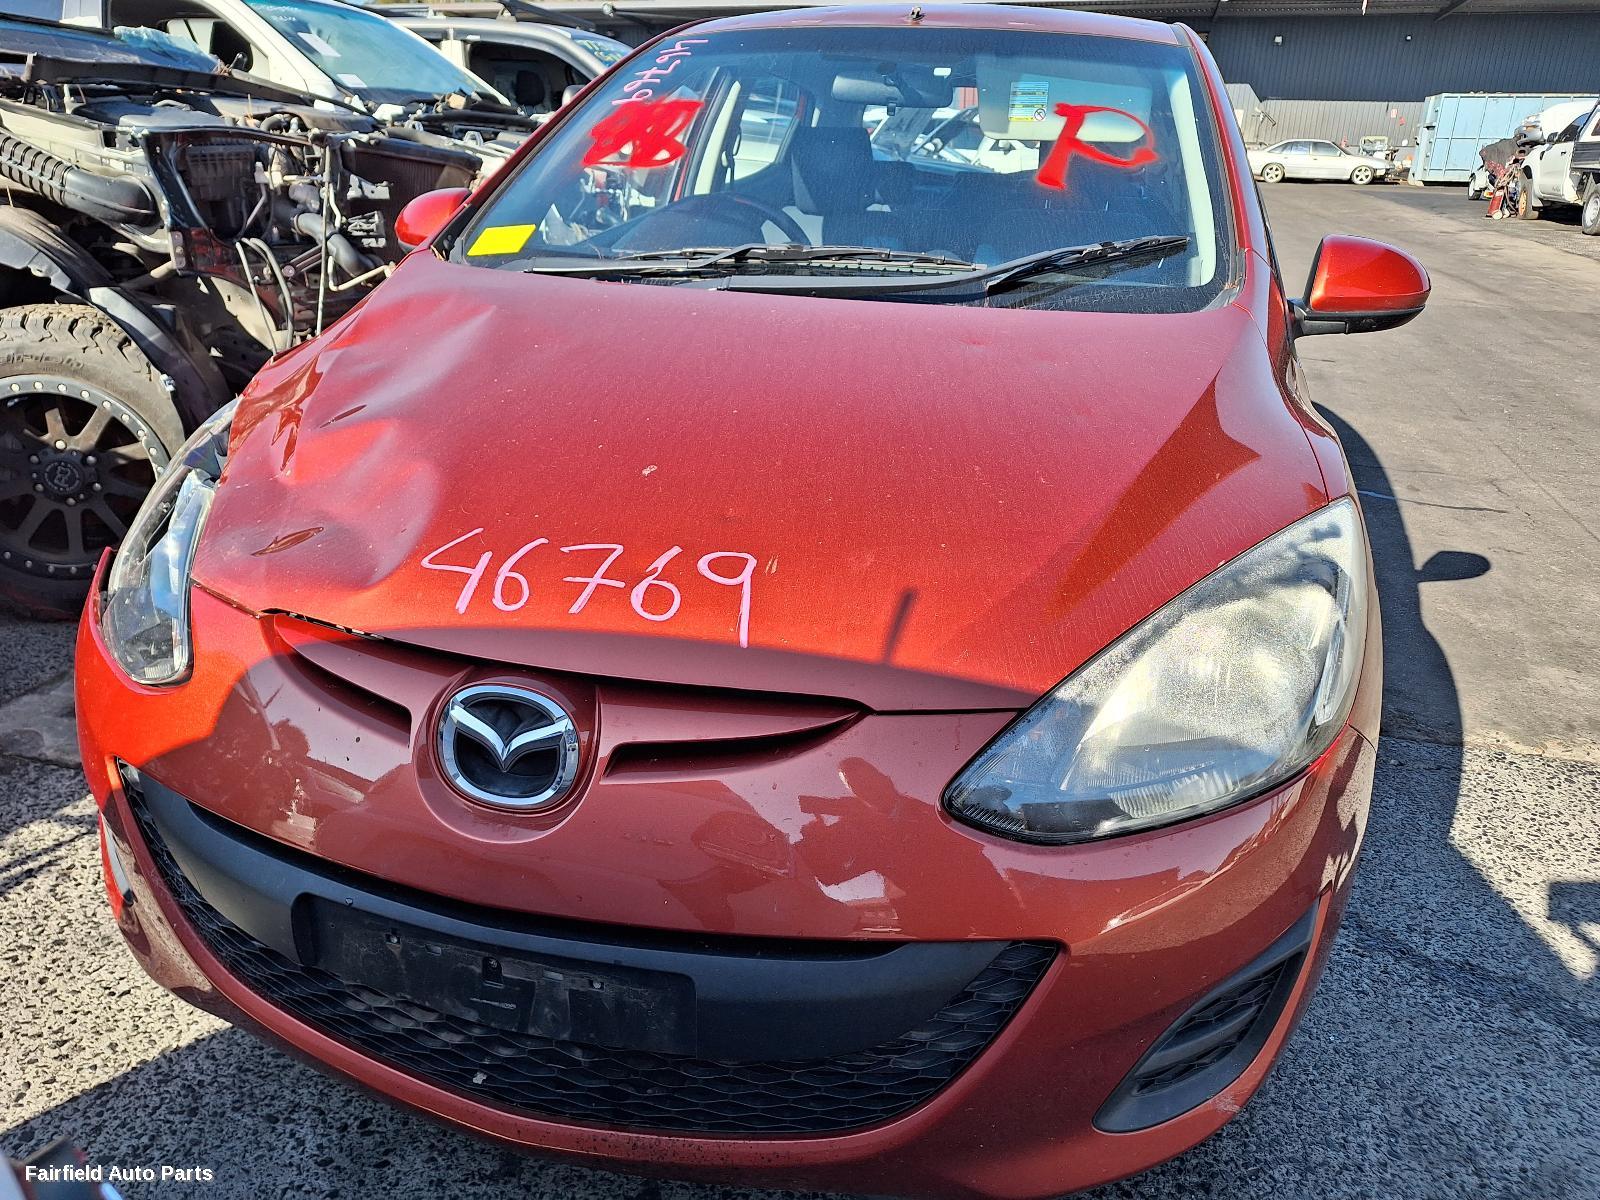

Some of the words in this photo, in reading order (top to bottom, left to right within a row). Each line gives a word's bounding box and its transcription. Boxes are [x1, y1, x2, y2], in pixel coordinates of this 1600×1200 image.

[611, 39, 709, 106] 46769
[1035, 102, 1160, 190] R
[420, 527, 758, 649] 46769
